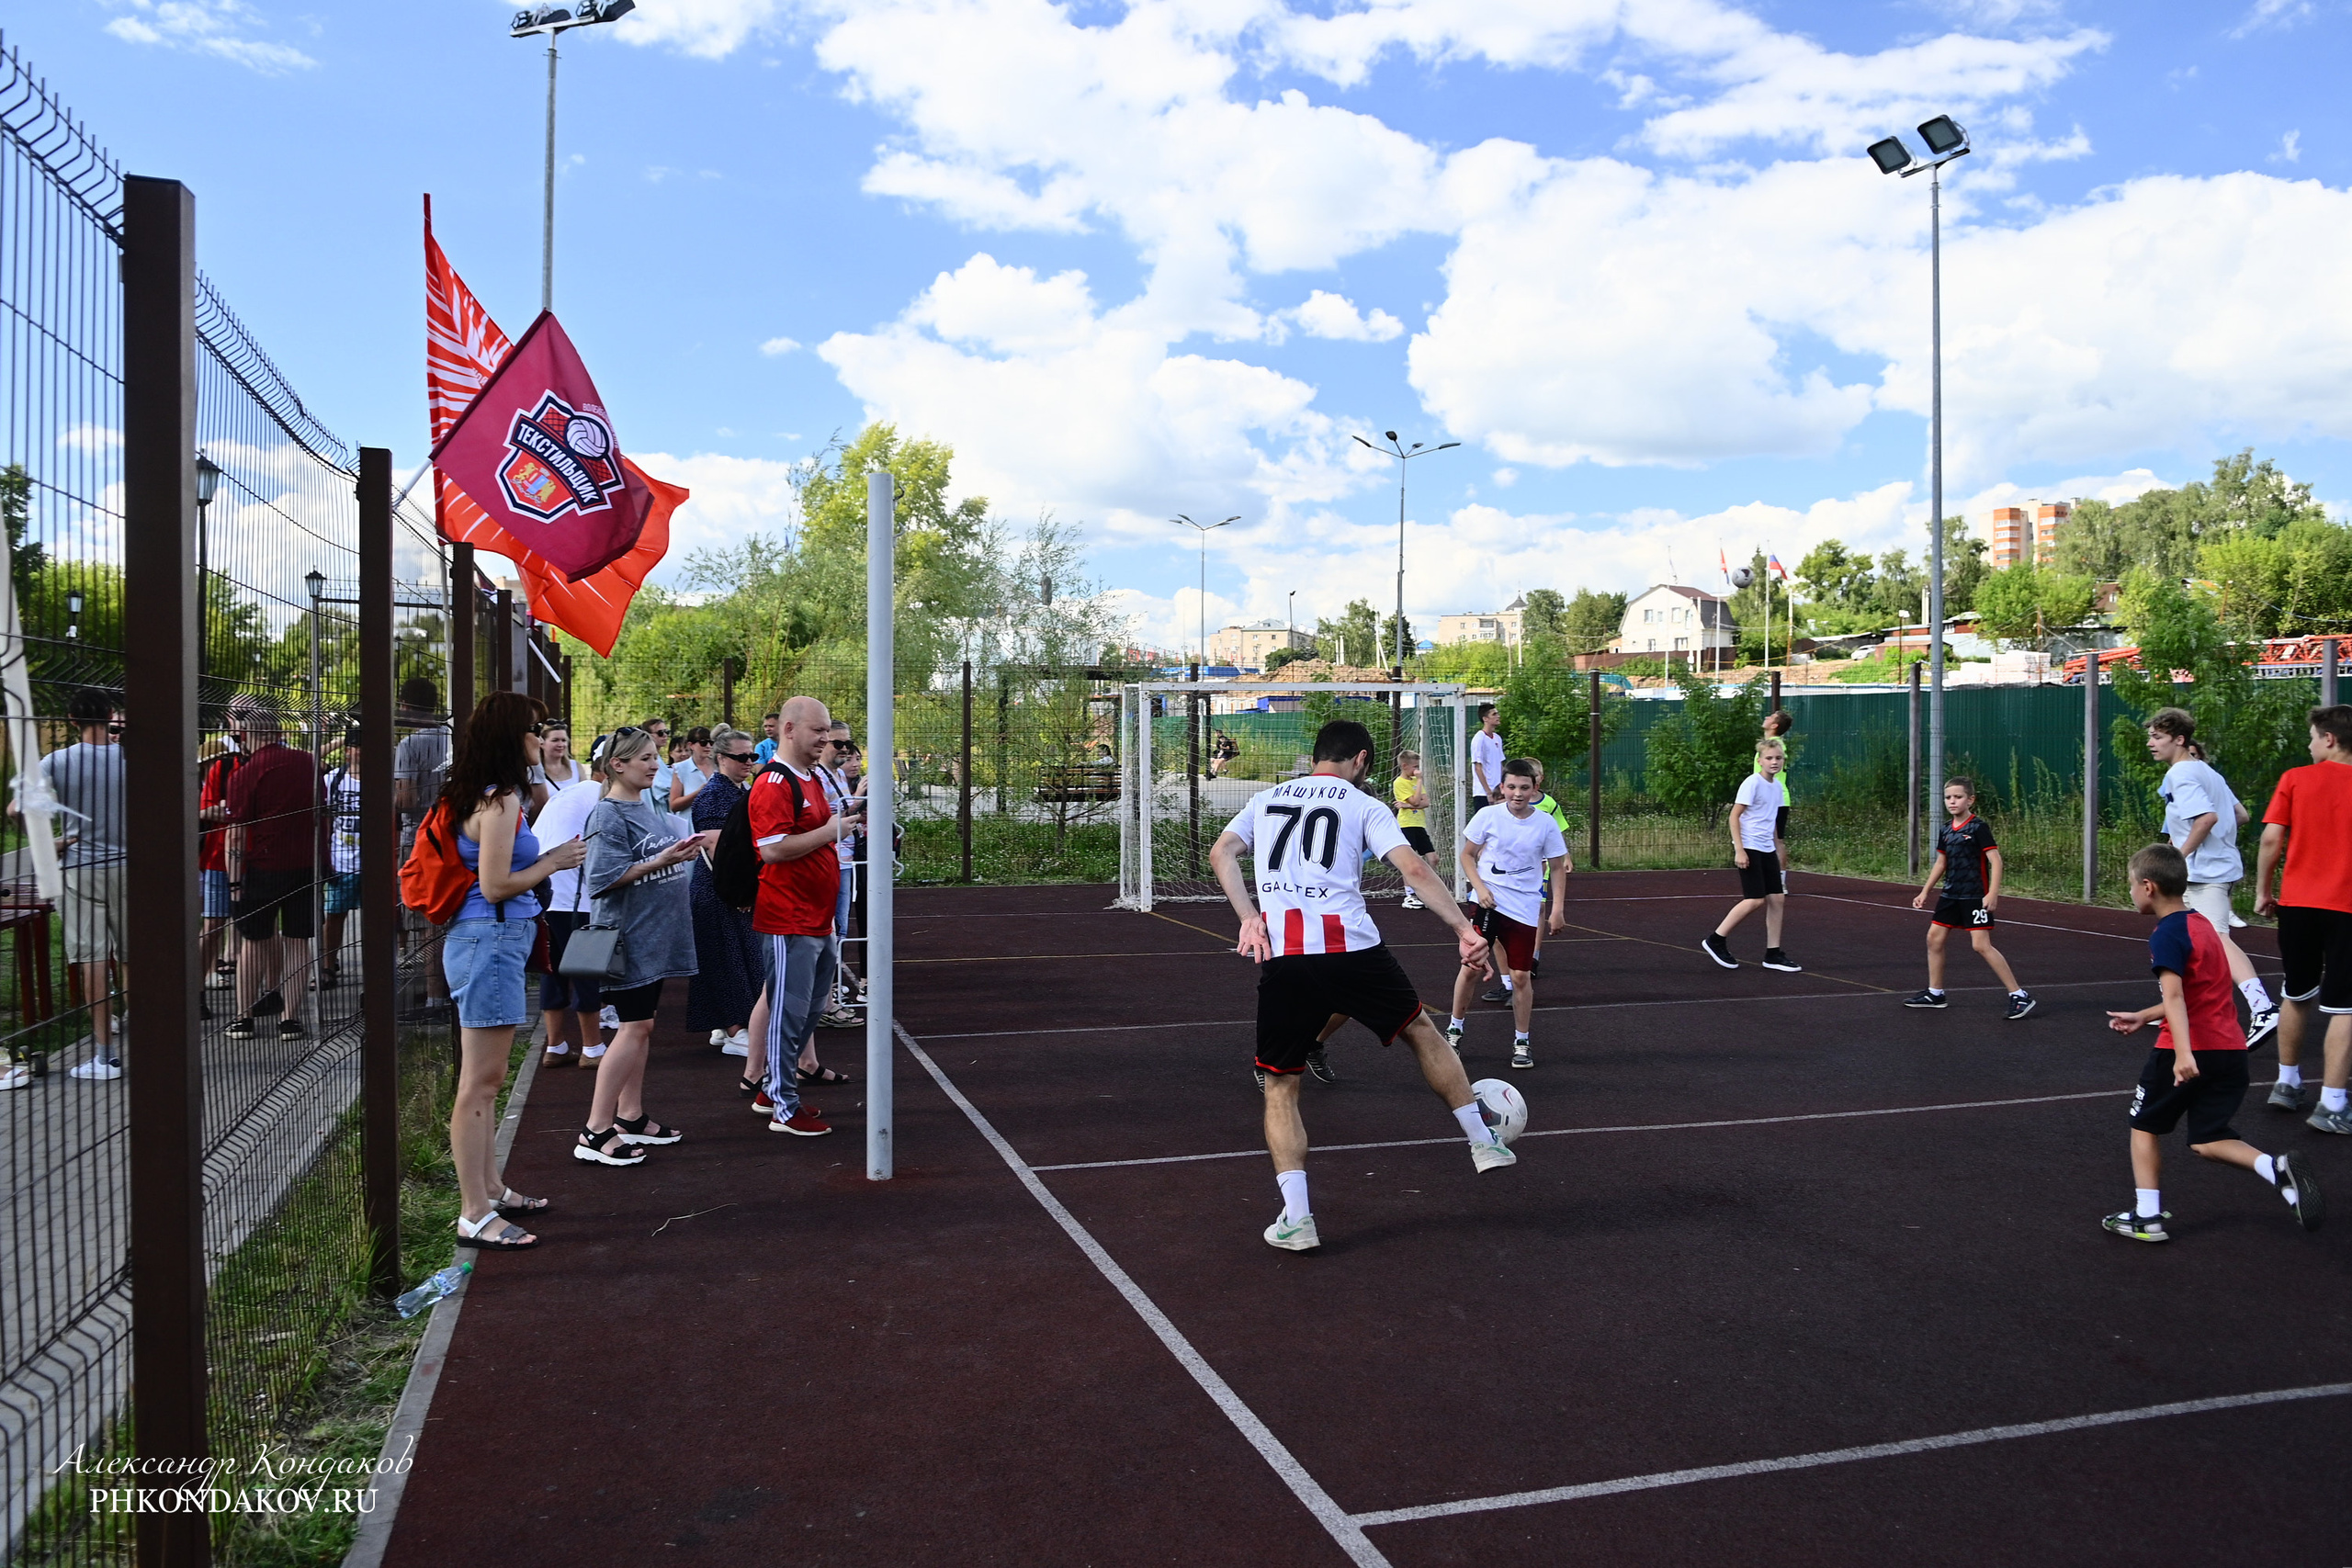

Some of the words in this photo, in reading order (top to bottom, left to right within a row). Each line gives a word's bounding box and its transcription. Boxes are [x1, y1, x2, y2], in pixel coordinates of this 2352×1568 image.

[517, 423, 599, 503] ТЕКСТИЛЬЩИК
[1272, 785, 1348, 800] МАШУКОВ
[1264, 804, 1340, 874] 70
[1261, 882, 1329, 898] GALTEX
[1972, 908, 1988, 924] 29
